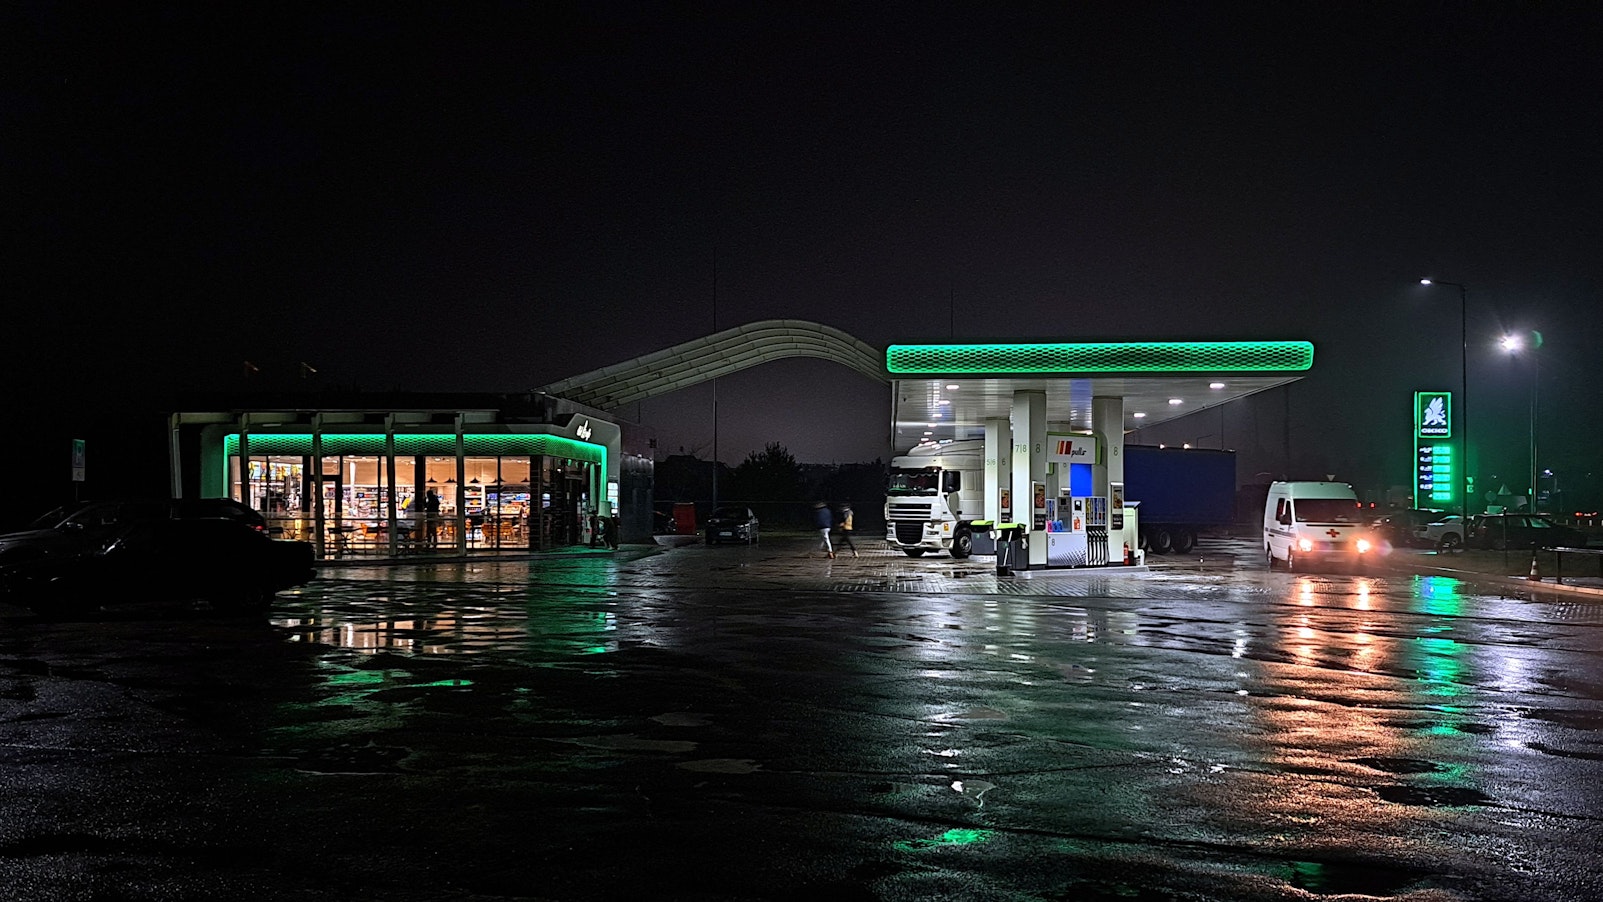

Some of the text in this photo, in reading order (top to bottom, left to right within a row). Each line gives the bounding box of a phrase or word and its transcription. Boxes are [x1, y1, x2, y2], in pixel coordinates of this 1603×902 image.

[1035, 443, 1041, 453] 8
[1113, 446, 1118, 456] 8
[1001, 458, 1006, 466] 6
